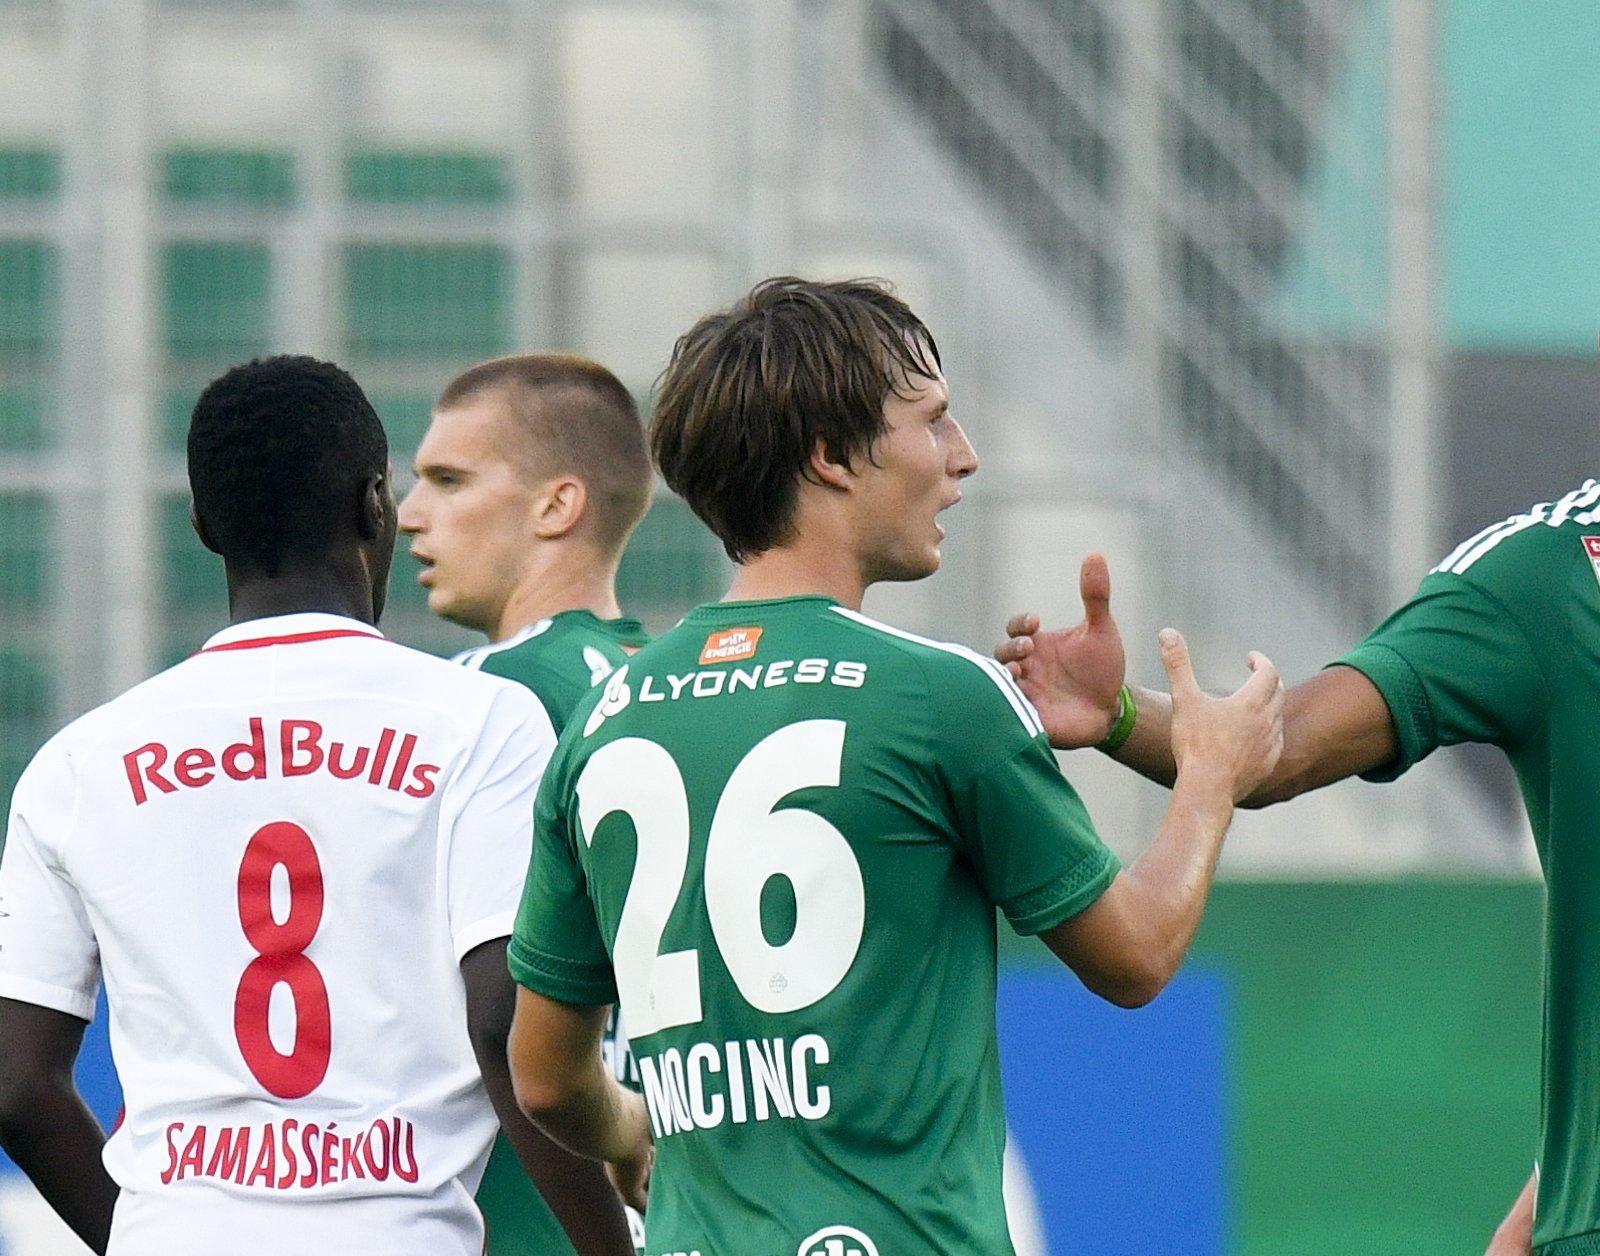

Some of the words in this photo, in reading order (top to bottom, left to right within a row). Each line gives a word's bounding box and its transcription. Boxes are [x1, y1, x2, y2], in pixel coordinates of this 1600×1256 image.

[638, 658, 868, 702] LYONESS
[123, 717, 265, 806] Red
[280, 719, 441, 800] Bulls
[575, 718, 866, 1040] 26
[234, 821, 332, 1100] 8
[160, 1115, 420, 1191] SAMASSÉKOU
